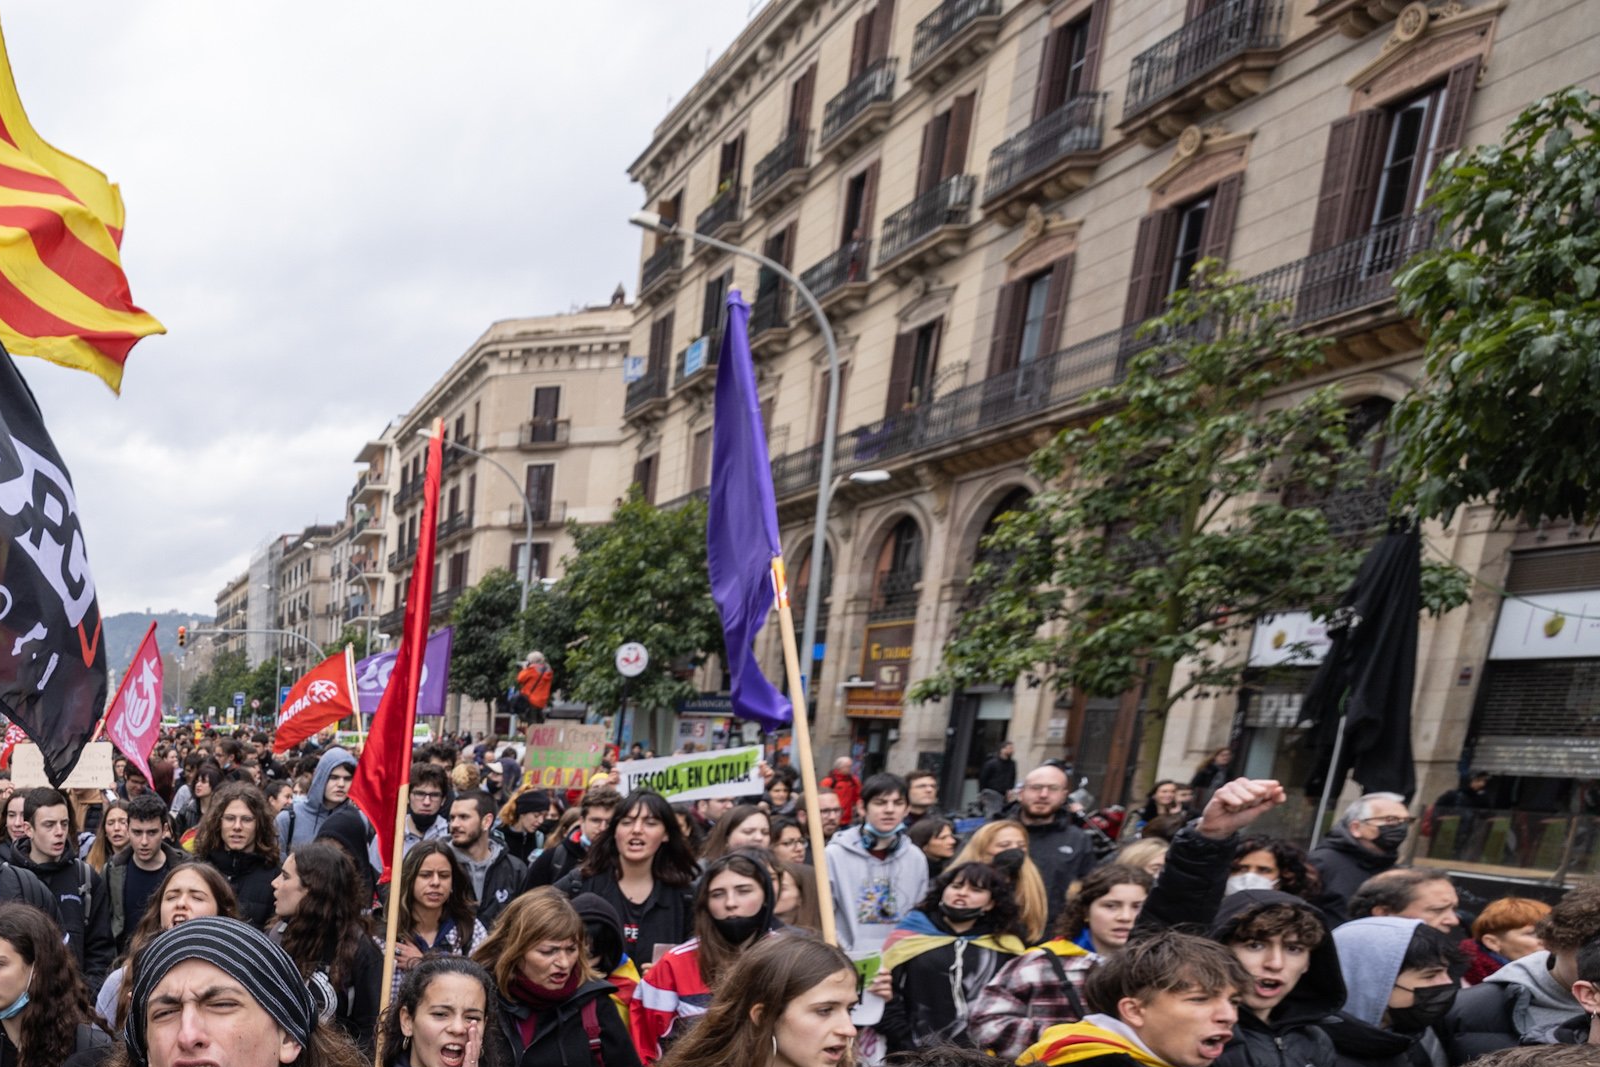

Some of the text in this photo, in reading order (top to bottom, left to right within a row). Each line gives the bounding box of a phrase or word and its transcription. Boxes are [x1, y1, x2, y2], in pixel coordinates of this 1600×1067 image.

[542, 765, 590, 788] CATAL
[688, 765, 703, 788] EN
[706, 754, 751, 786] CATALÀ
